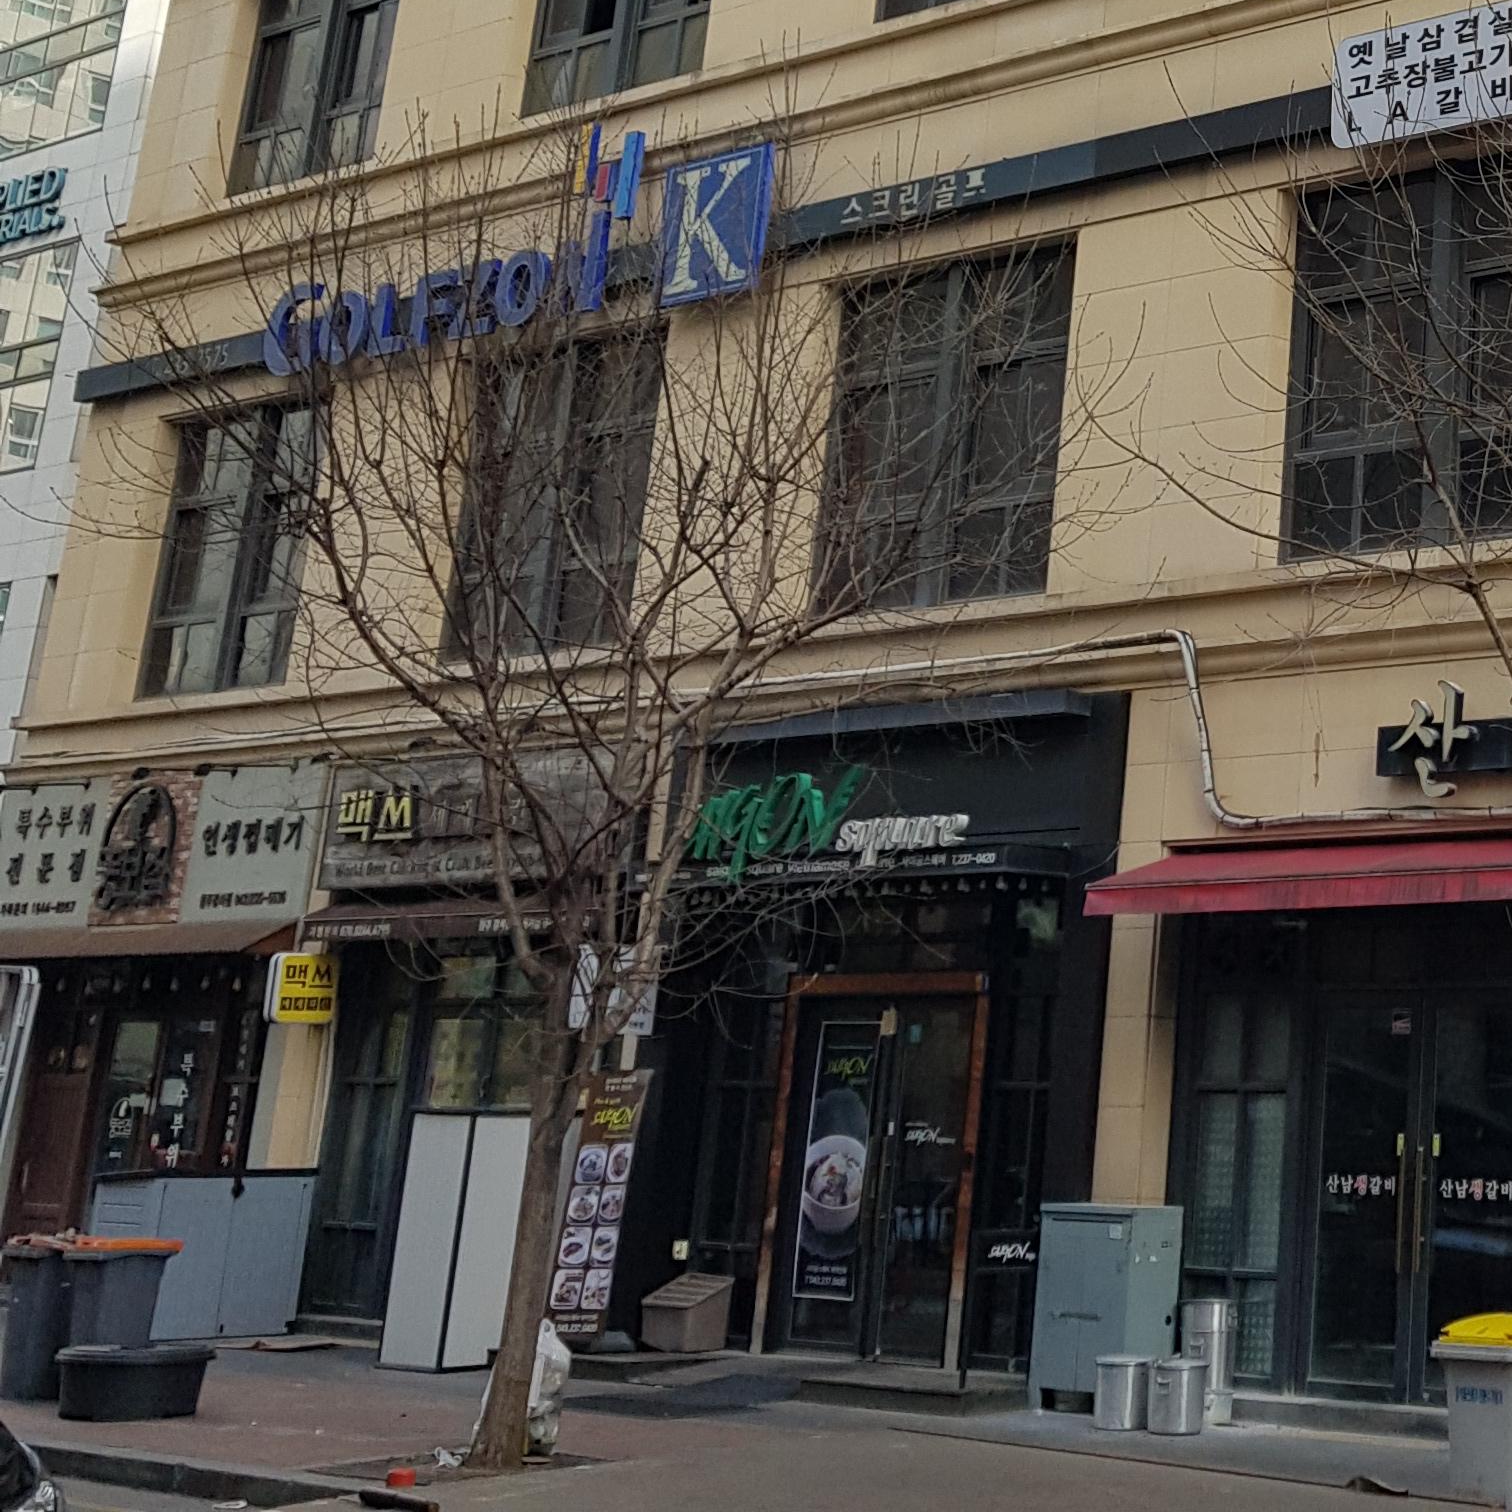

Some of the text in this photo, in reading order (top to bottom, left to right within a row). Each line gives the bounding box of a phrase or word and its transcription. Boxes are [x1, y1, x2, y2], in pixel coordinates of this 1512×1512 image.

[834, 813, 971, 868] square
[1325, 1173, 1397, 1196] 산남생갈비
[1438, 1178, 1512, 1201] 산남생갈비
